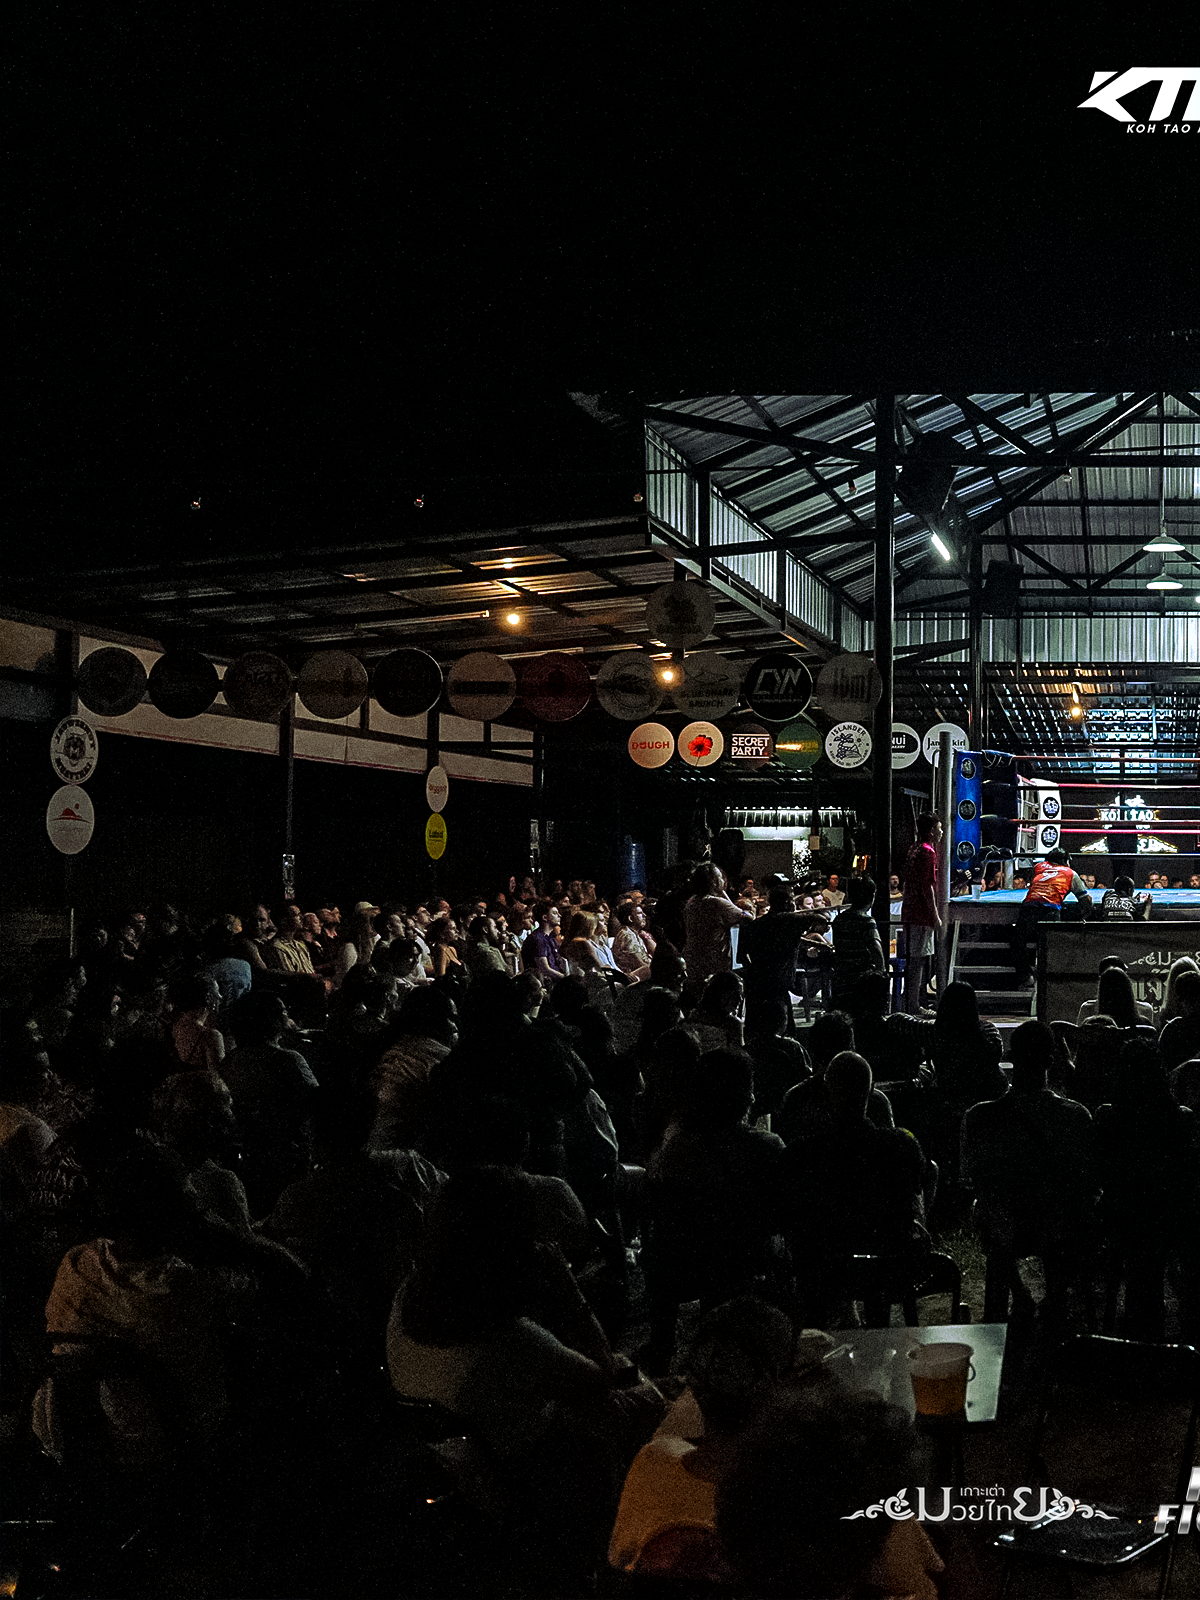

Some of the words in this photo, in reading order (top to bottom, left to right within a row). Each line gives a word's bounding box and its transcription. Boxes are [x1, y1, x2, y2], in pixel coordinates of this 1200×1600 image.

[831, 724, 867, 737] ISLANDER
[631, 741, 670, 750] DOUGH
[731, 737, 770, 747] SECRET
